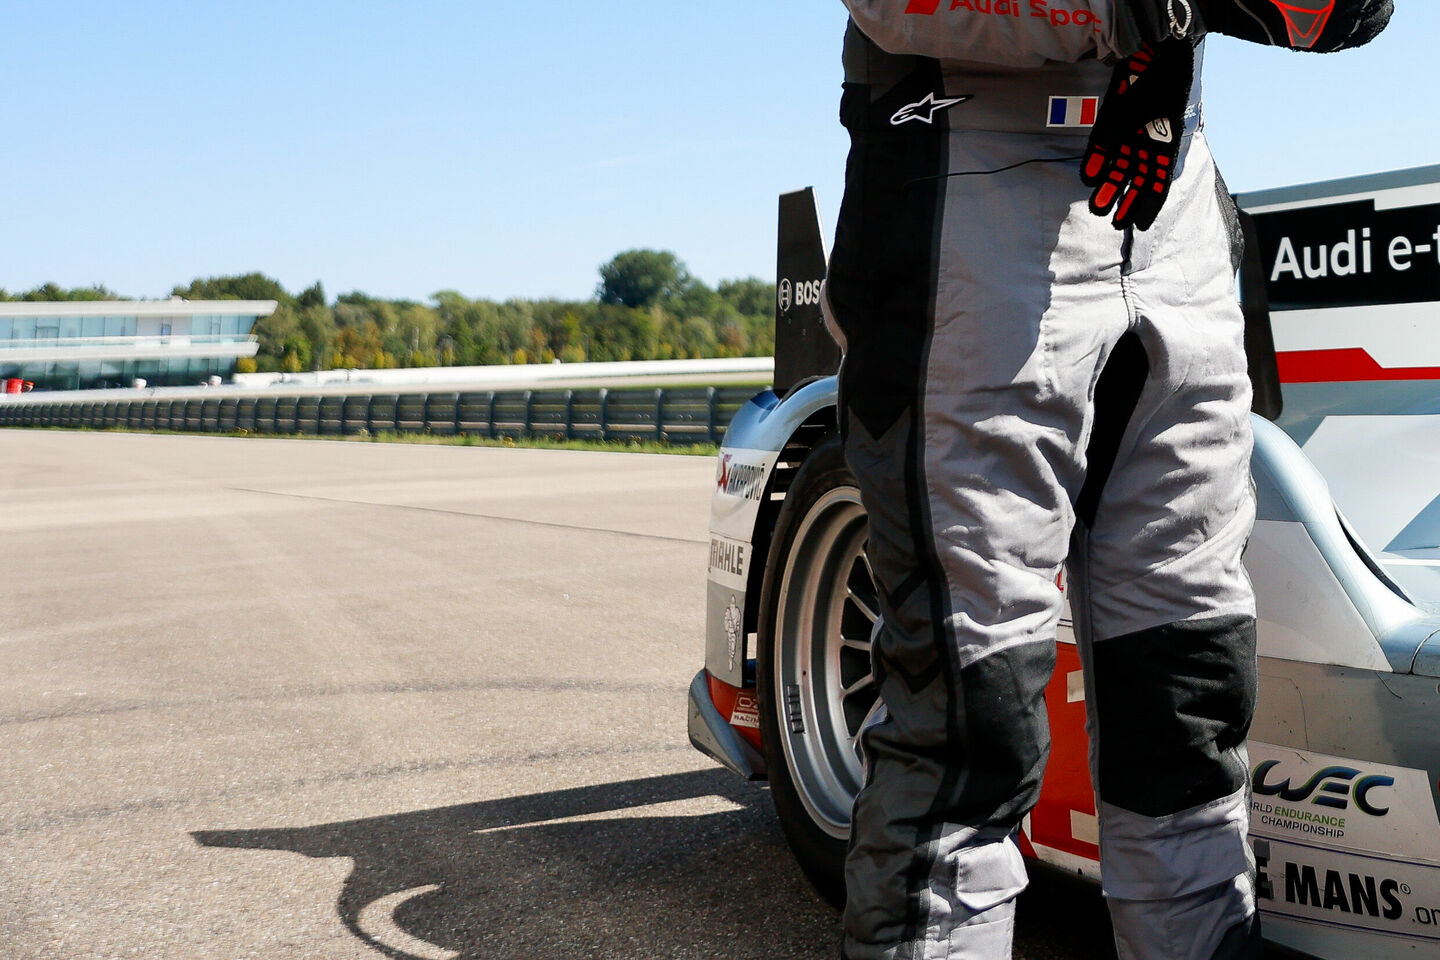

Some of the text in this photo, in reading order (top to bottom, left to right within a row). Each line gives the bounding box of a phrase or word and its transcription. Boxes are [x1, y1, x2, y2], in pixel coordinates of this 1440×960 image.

[1270, 228, 1372, 282] Audi
[711, 539, 744, 576] MAHLE
[1252, 759, 1395, 817] WEC
[1261, 815, 1345, 839] CHAMPIONSHIP
[1274, 806, 1346, 828] ENDURANCE
